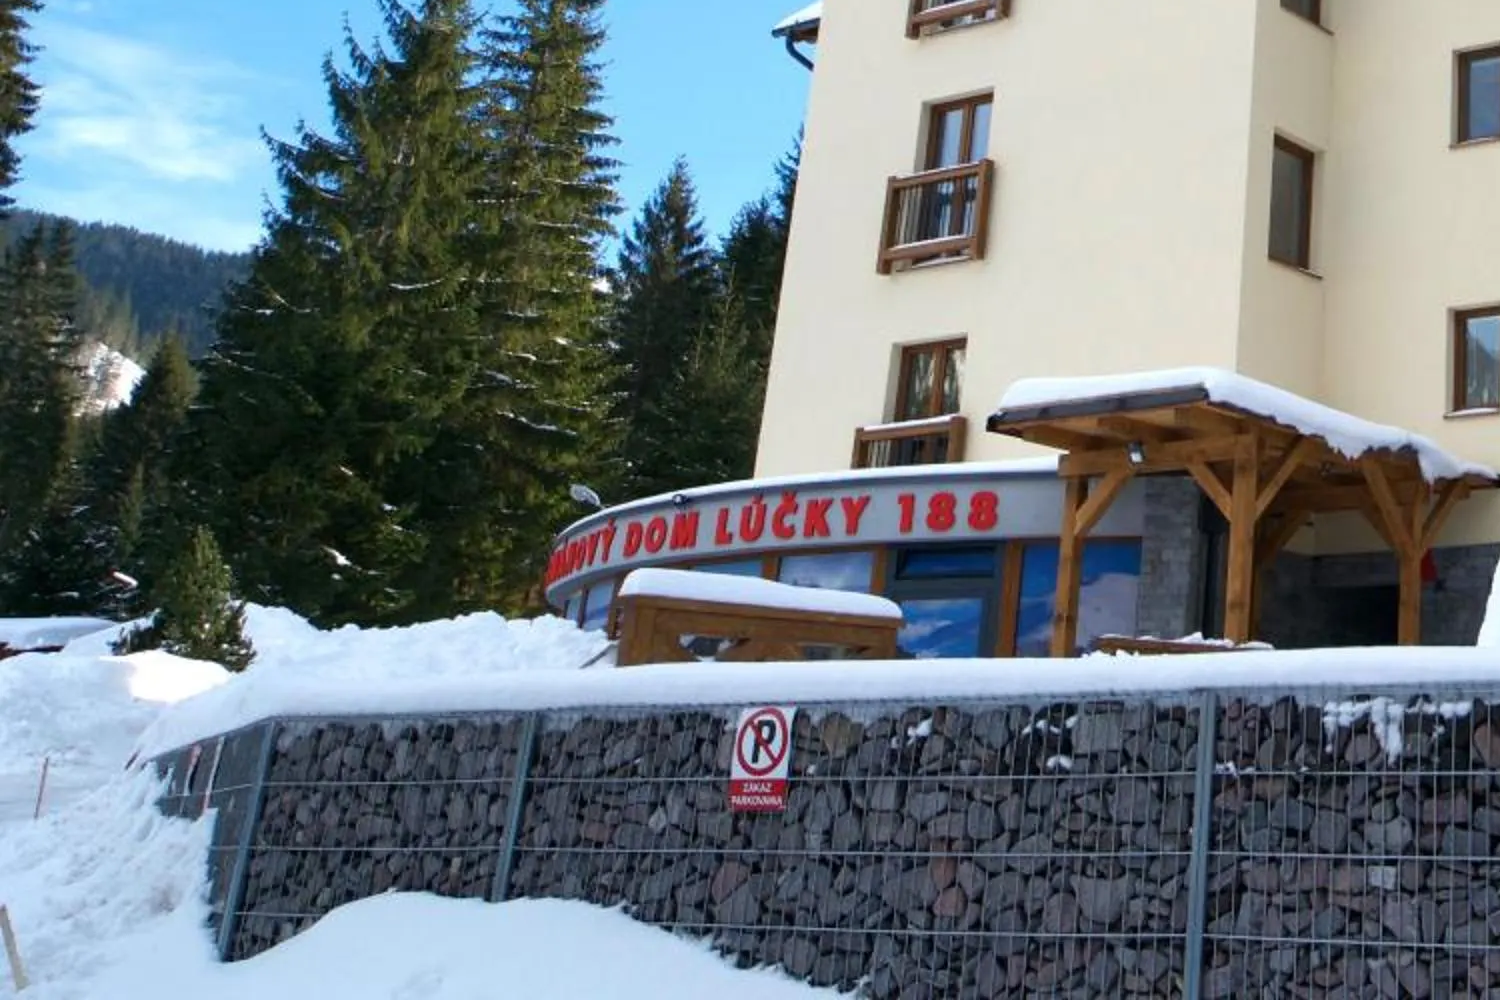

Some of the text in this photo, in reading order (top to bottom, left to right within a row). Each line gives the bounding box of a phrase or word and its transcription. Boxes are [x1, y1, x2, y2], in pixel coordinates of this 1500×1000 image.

[623, 511, 699, 558] DOM
[715, 490, 871, 545] LÚČKY
[898, 491, 999, 533] 188
